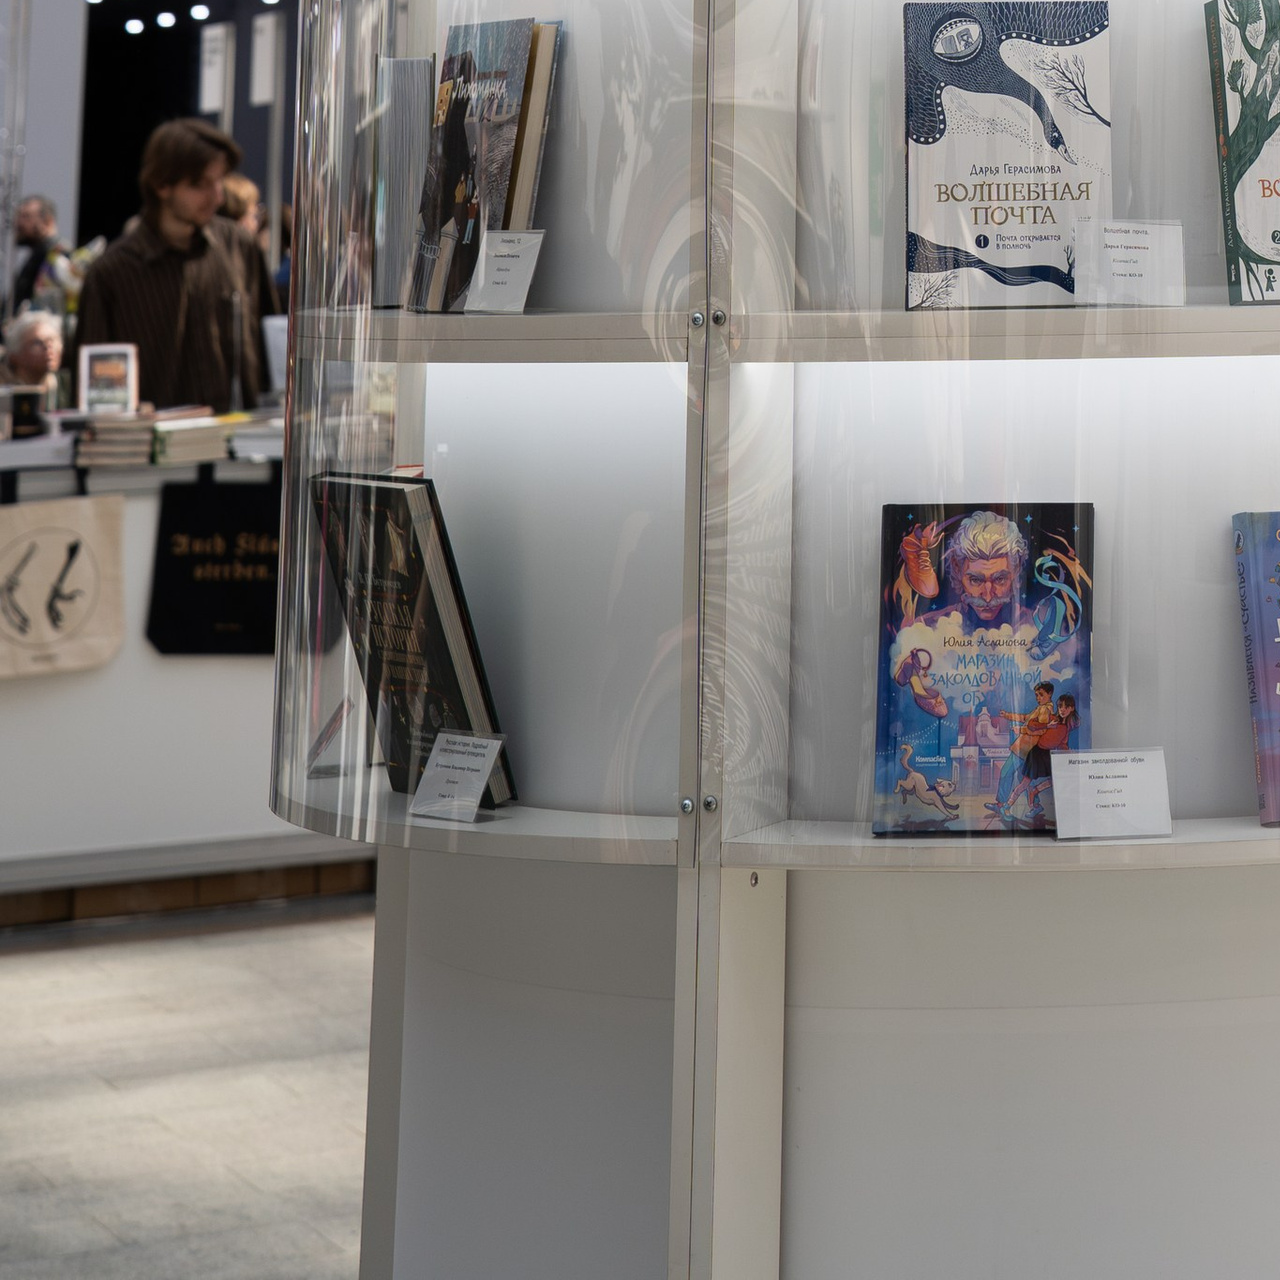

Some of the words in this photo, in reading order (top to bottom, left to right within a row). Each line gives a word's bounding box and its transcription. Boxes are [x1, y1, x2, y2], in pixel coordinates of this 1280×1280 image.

[934, 181, 1092, 202] ВОЛШЕБНАЯ
[970, 205, 1057, 225] ПОЧТА
[943, 636, 974, 647] Юлия
[977, 635, 1028, 647] Асланова
[956, 654, 1016, 670] МАГАЗИН
